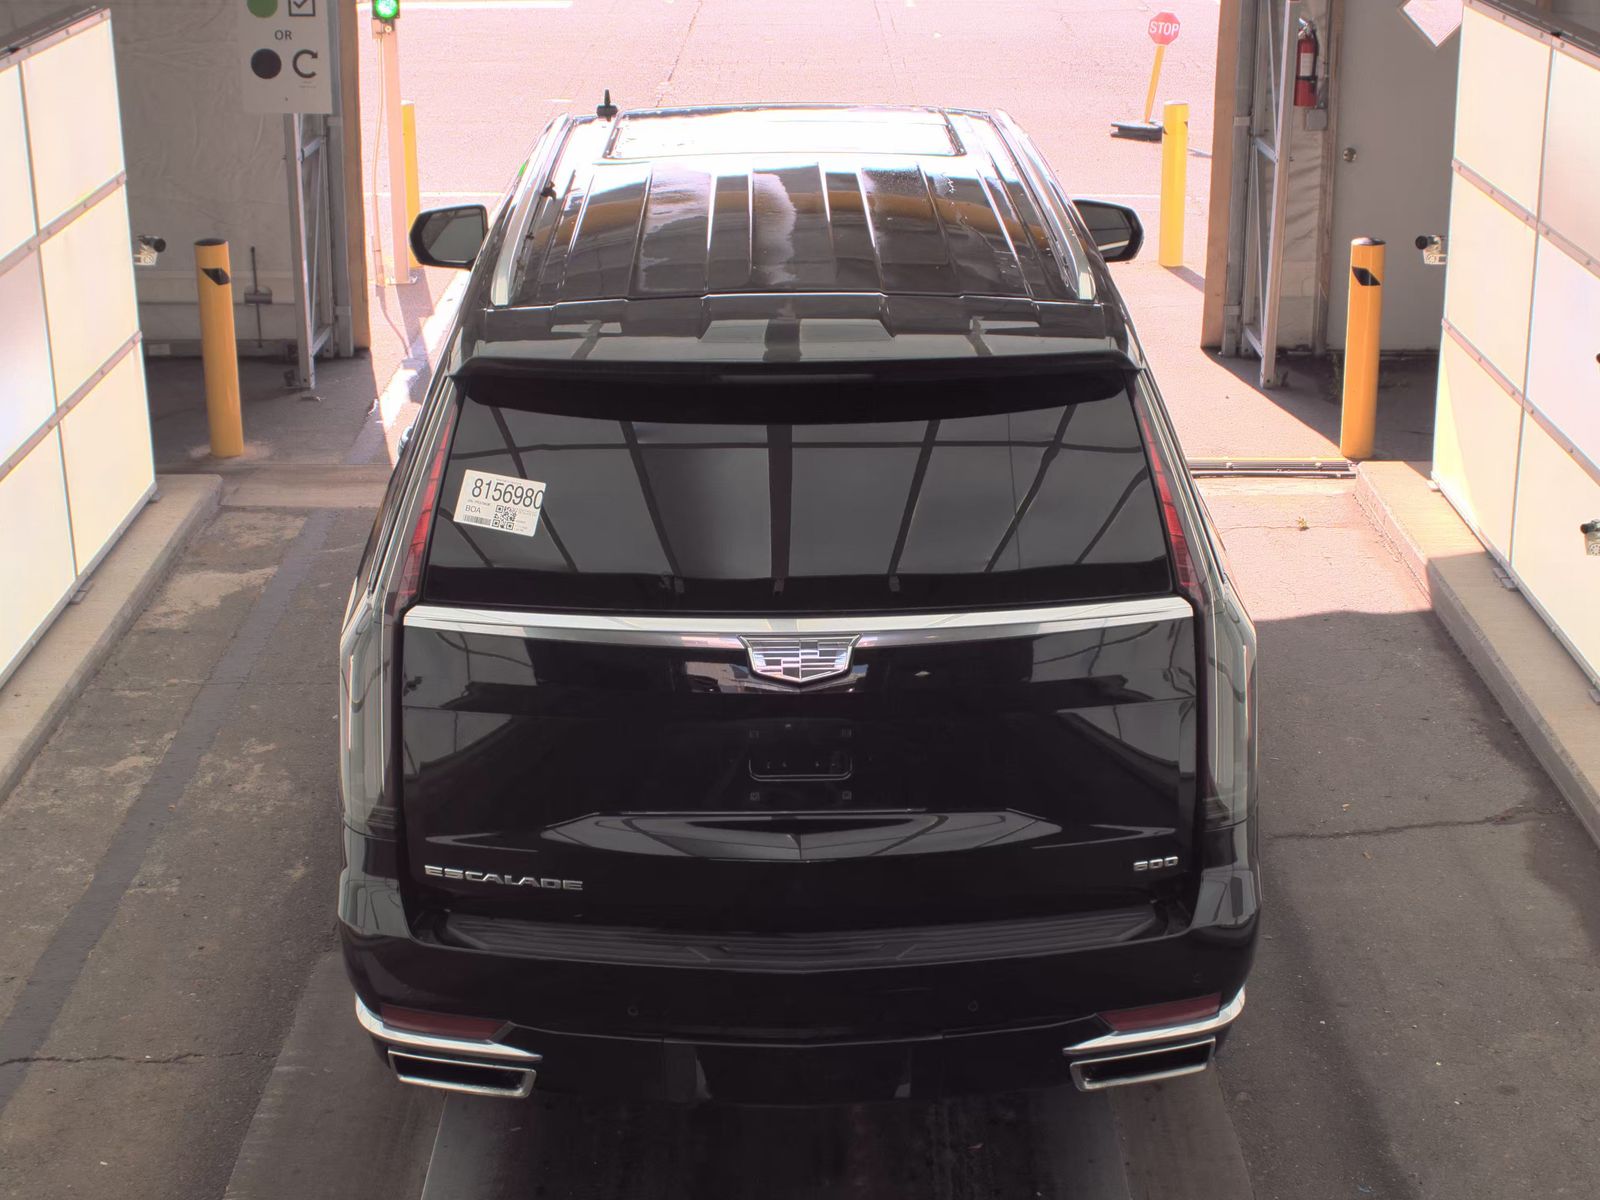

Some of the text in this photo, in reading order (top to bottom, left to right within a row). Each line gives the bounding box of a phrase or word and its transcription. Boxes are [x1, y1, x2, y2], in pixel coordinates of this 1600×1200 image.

[274, 30, 292, 41] OR
[1150, 21, 1179, 36] STOP
[471, 478, 544, 510] 8156980
[465, 504, 481, 514] BOA
[424, 865, 583, 890] ESCALADE
